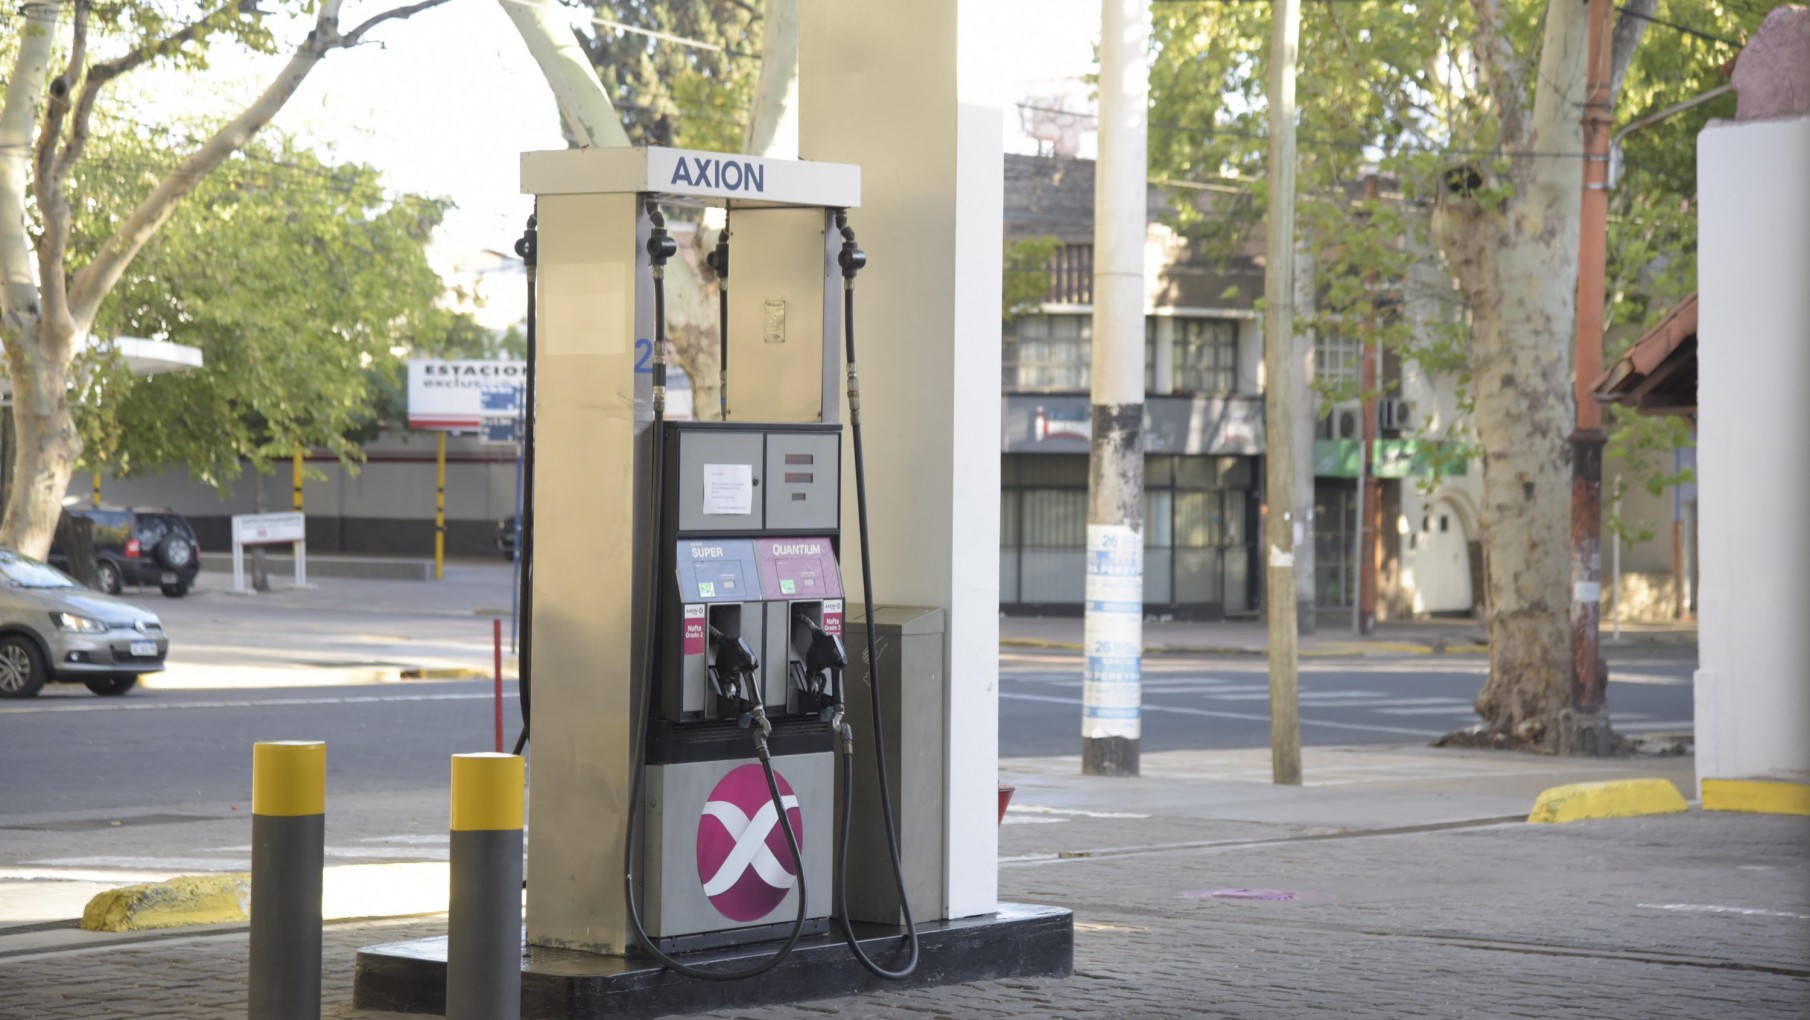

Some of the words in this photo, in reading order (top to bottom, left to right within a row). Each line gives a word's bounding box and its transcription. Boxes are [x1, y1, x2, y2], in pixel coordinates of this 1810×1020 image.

[671, 156, 764, 192] AXION
[634, 338, 654, 374] 2
[691, 547, 724, 558] SUPER
[772, 544, 821, 556] QUANTIUM
[826, 617, 840, 625] Nafta
[687, 624, 702, 632] Nafta
[685, 631, 700, 639] Grado
